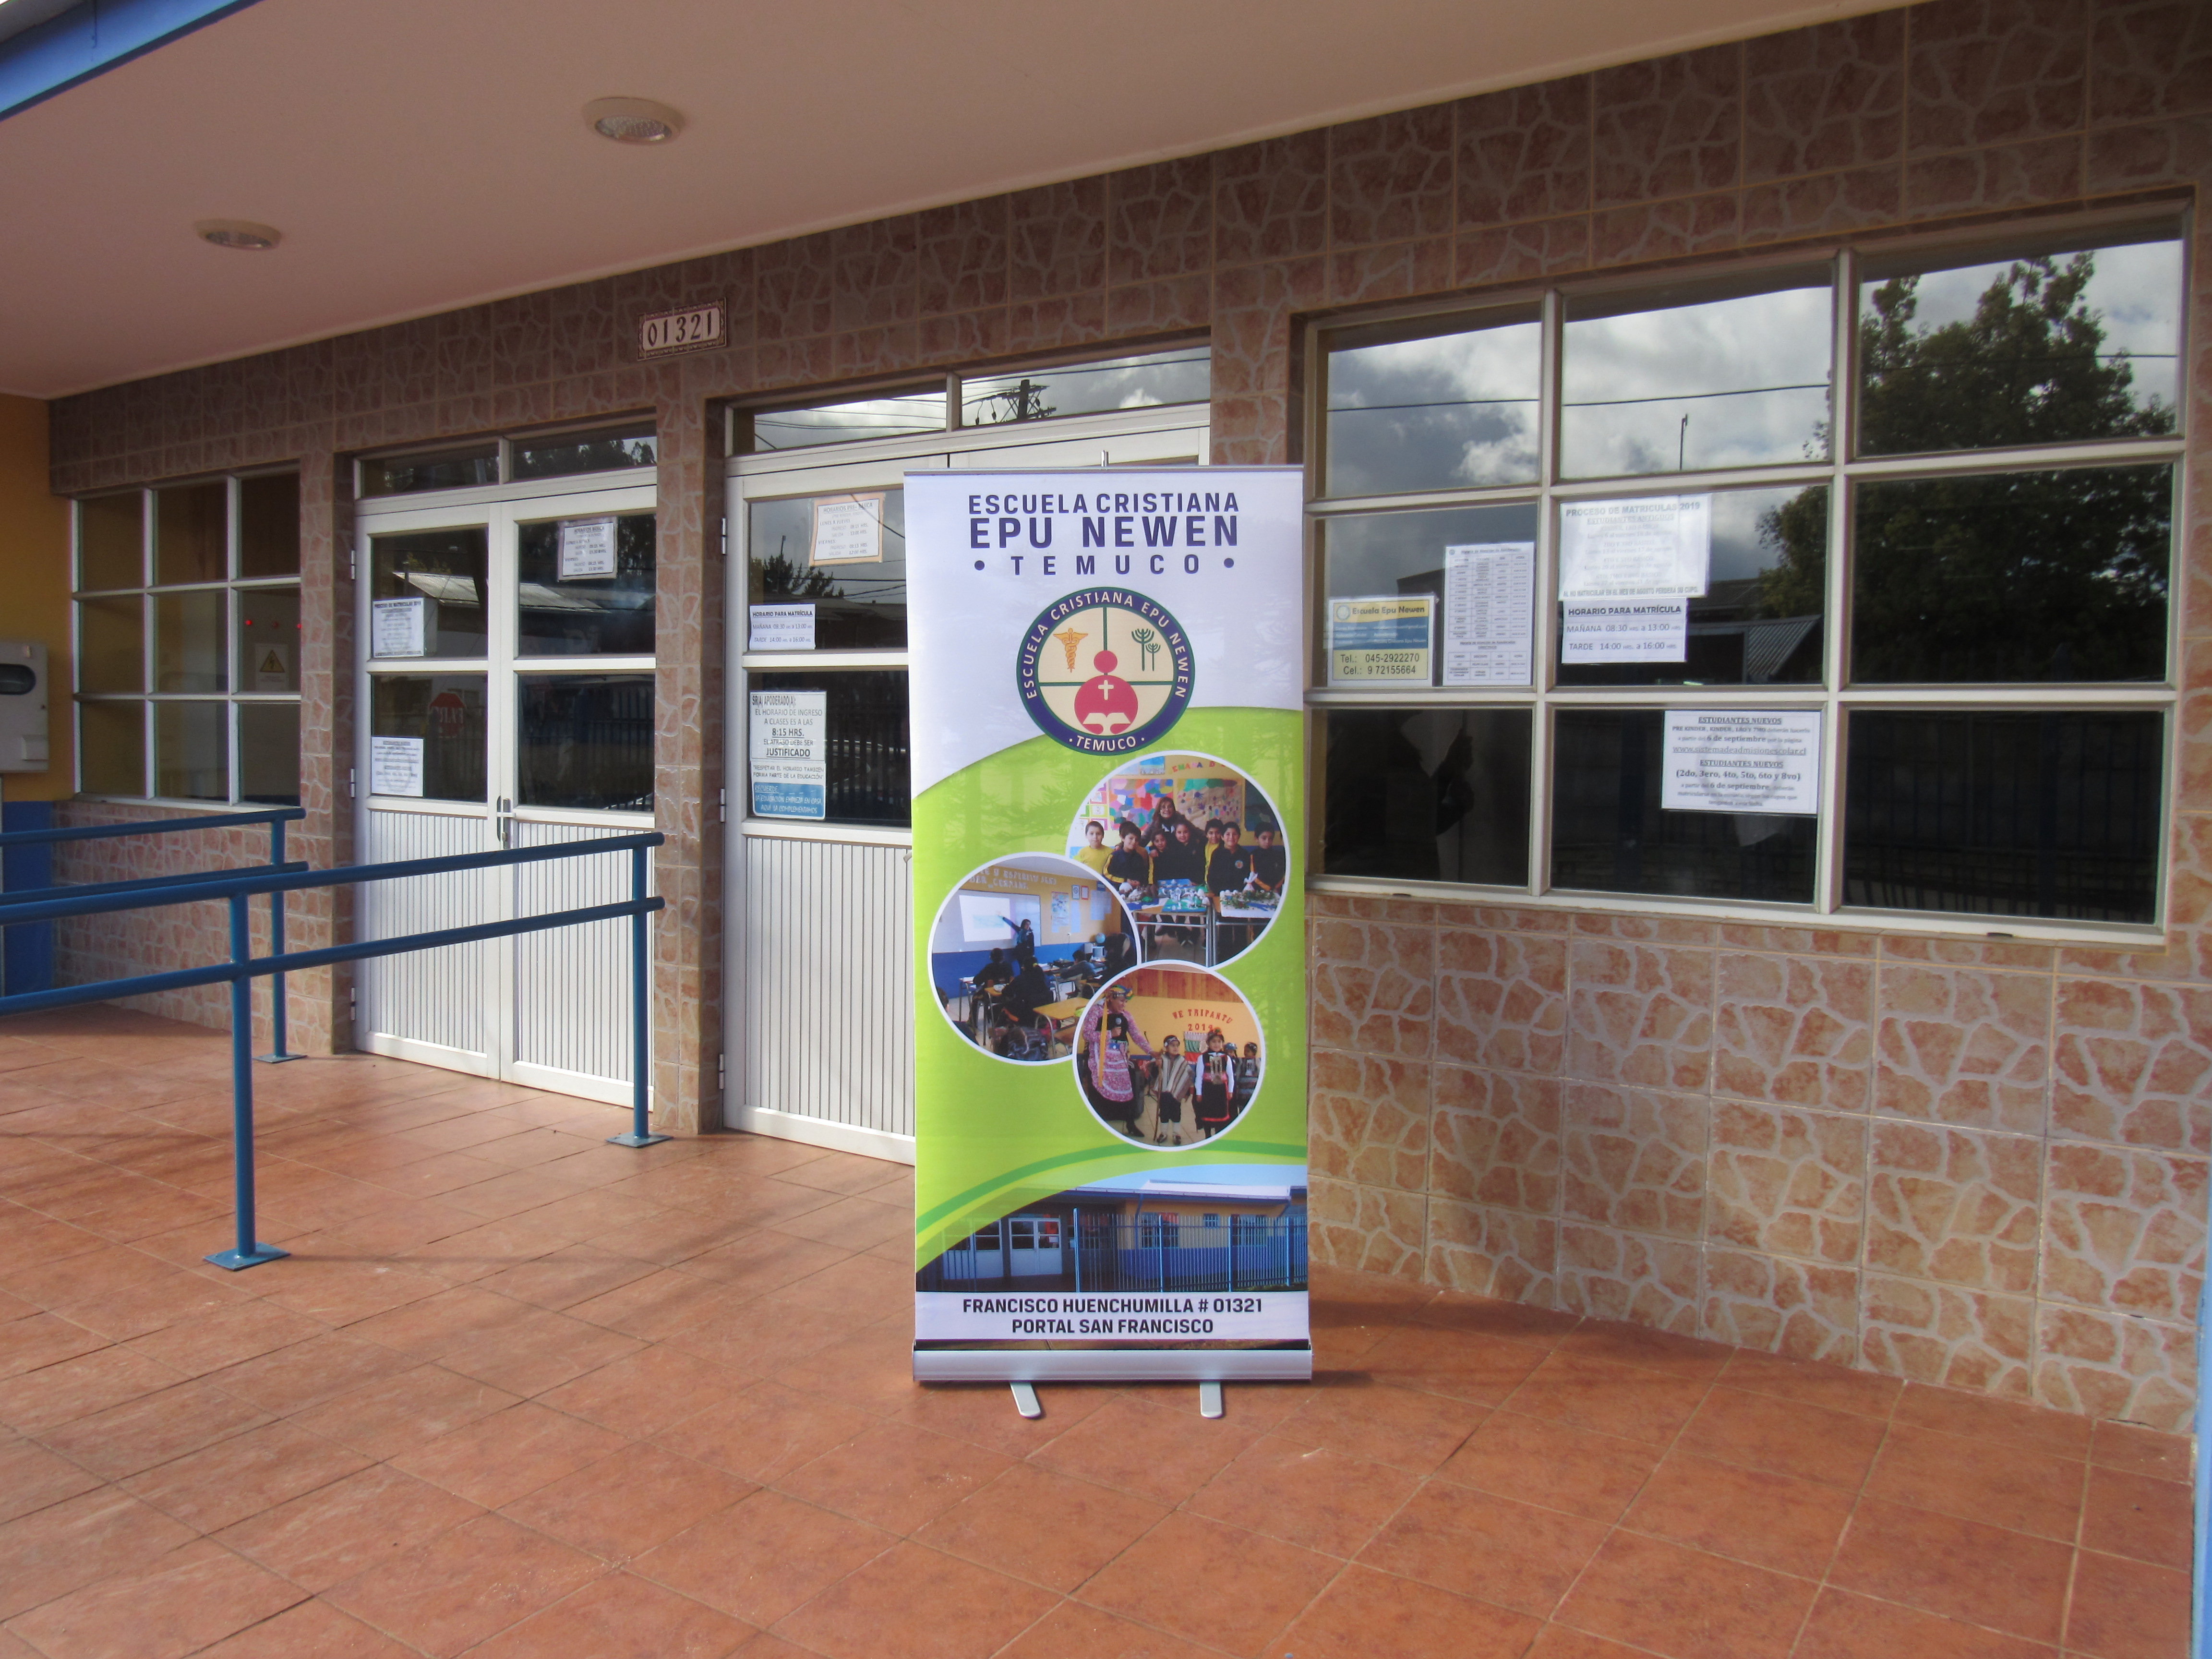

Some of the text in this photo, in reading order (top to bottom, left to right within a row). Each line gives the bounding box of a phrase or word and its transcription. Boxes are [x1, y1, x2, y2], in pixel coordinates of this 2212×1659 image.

[648, 311, 712, 347] 01321
[969, 492, 1239, 515] ESCUELA CRISTIANA
[1566, 508, 1606, 517] PROCESO
[1680, 502, 1700, 510] 2019
[970, 516, 1238, 549] EPU NEWEN
[1010, 554, 1199, 576] TEMUCO
[1382, 607, 1396, 615] Epu
[1633, 604, 1681, 613] MATRÍCULA
[1566, 625, 1602, 633] MAÑANA
[1022, 591, 1189, 699] ESCUELA CRISTIANA EPU NEWEN
[1341, 653, 1419, 663] Tel.: 045-2922270
[1344, 665, 1416, 675] Cel.: 9 72155664
[772, 728, 804, 737] 8:15 HRS.
[1076, 735, 1136, 751] TEMUCO
[766, 748, 811, 757] JUSTIFICADO
[1676, 769, 1697, 778] (2do,
[1722, 770, 1738, 779] 4to,
[1781, 772, 1801, 781] 8vo)
[963, 1298, 1262, 1313] FRANCISCO HUENCHUMILLA # 01321
[1012, 1318, 1214, 1334] PORTAL SAN FRANCISCO
